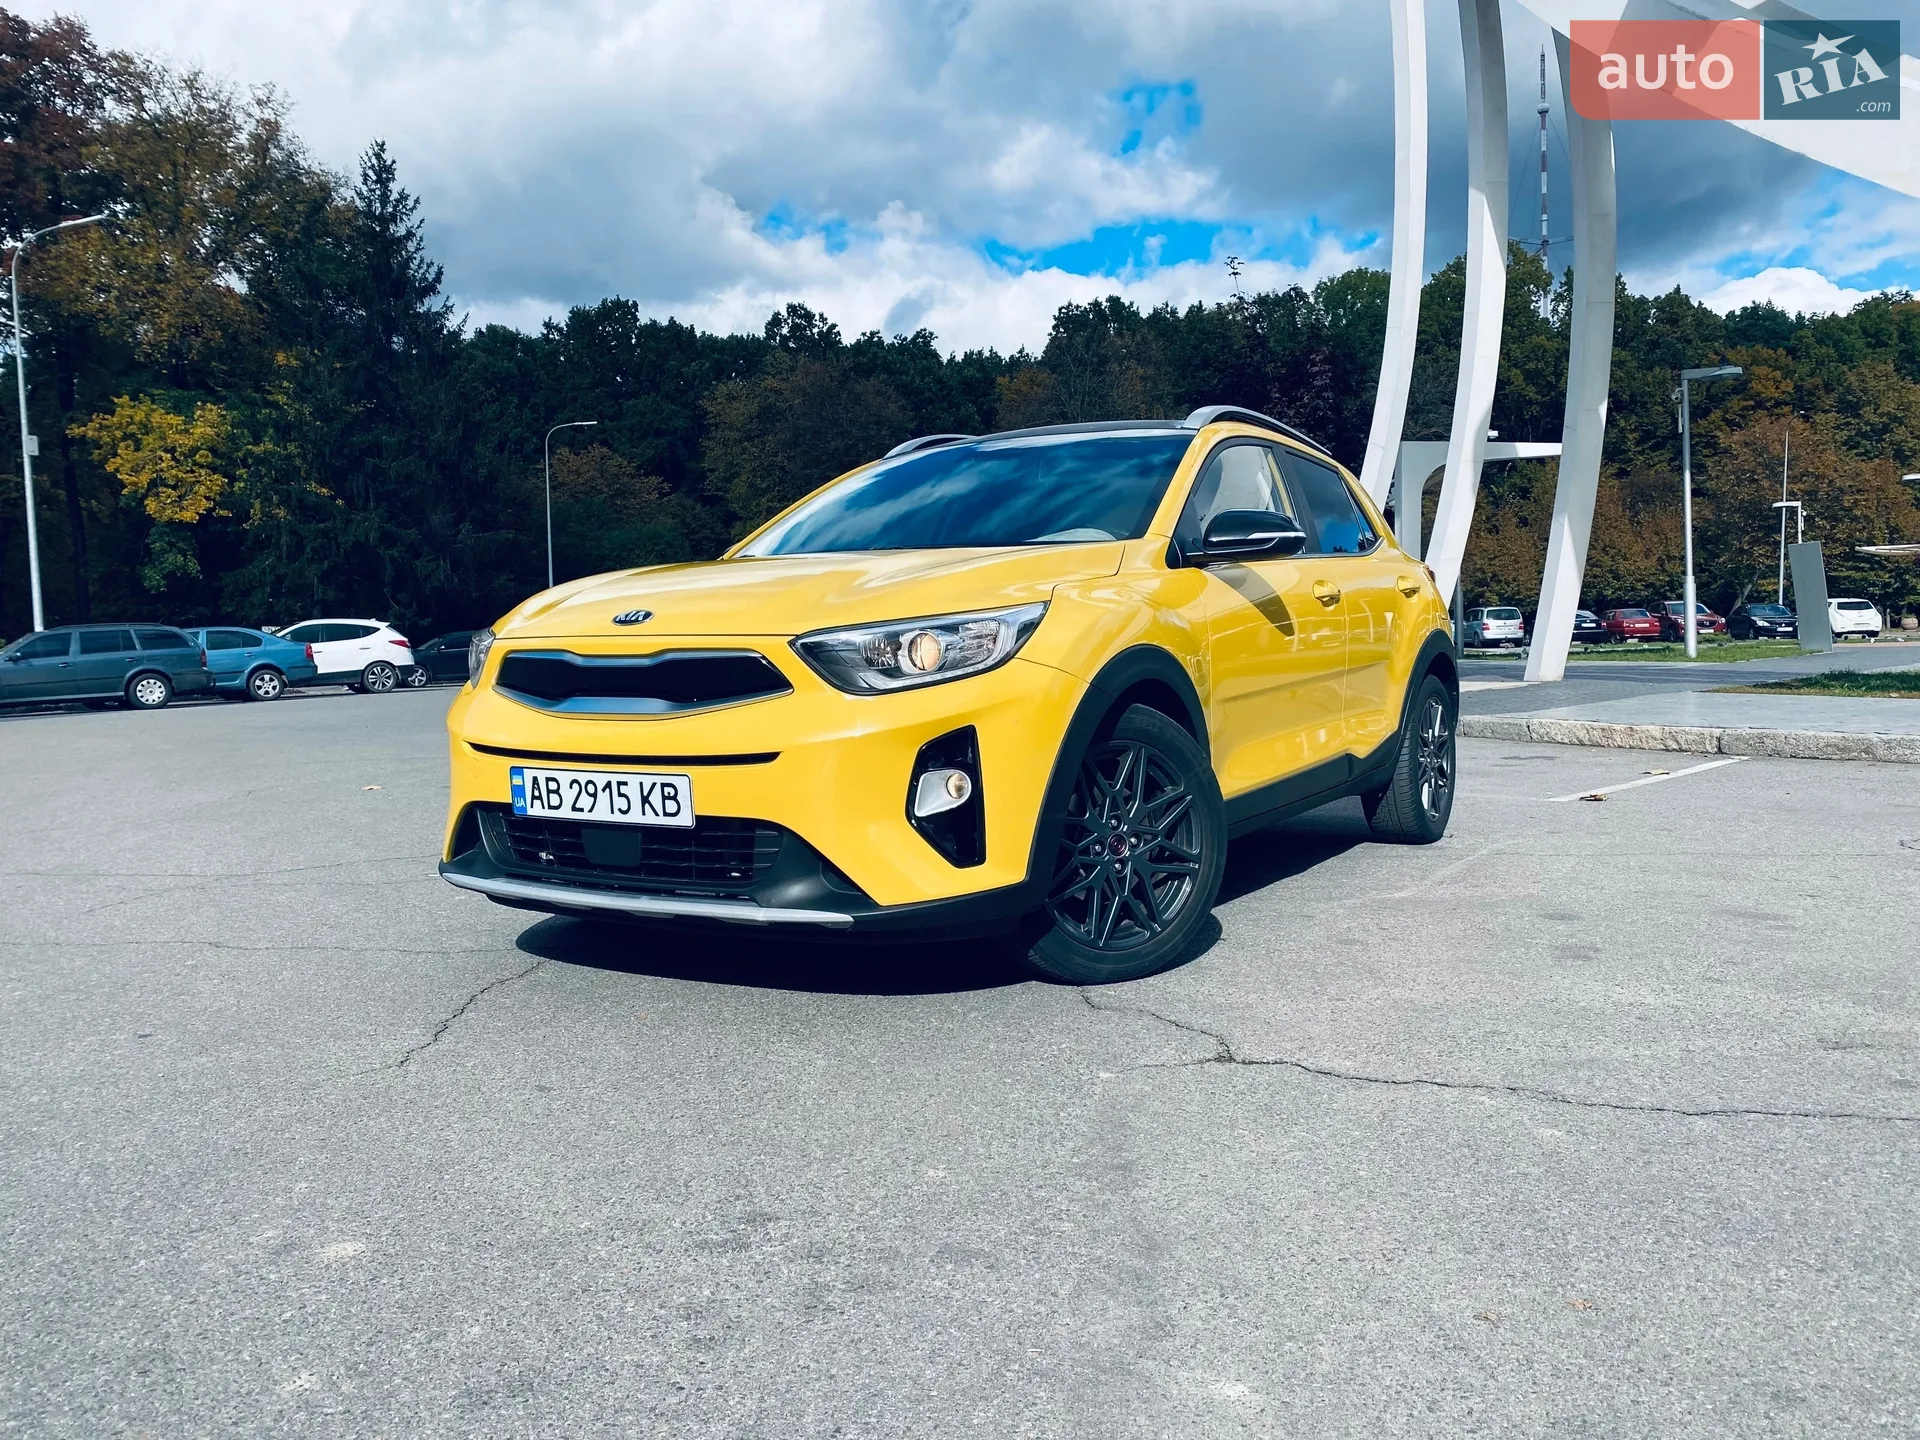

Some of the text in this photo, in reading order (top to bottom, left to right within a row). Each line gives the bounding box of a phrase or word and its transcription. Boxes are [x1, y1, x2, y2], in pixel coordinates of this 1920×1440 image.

[514, 796, 526, 808] UA
[530, 775, 682, 818] AB 2915 KB
